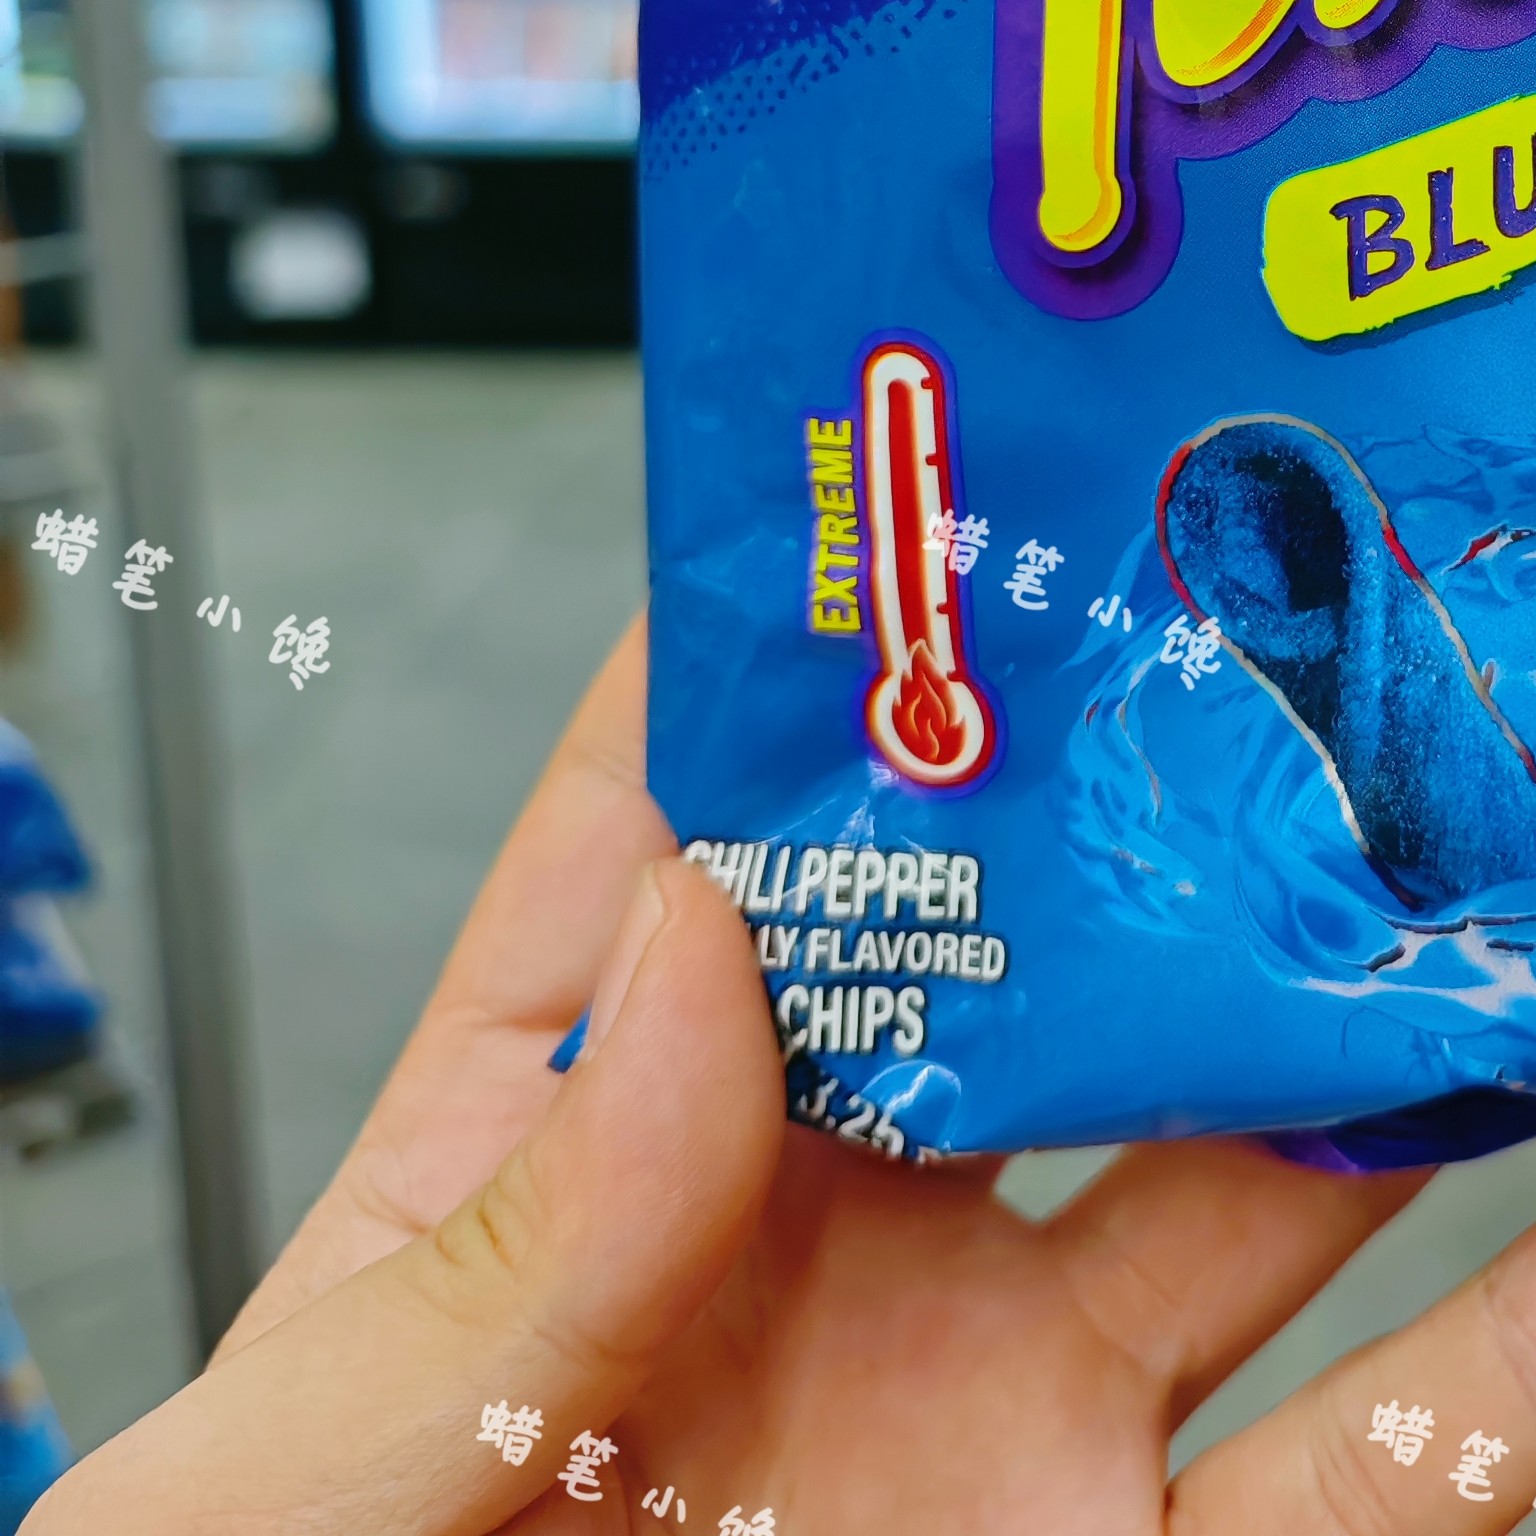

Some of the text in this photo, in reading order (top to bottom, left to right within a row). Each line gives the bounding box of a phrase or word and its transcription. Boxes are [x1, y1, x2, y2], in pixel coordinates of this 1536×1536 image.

[809, 417, 862, 633] EXTREME
[795, 845, 980, 923] PEPPER
[804, 927, 1006, 983] FLAVORED
[777, 982, 926, 1059] CHIPS
